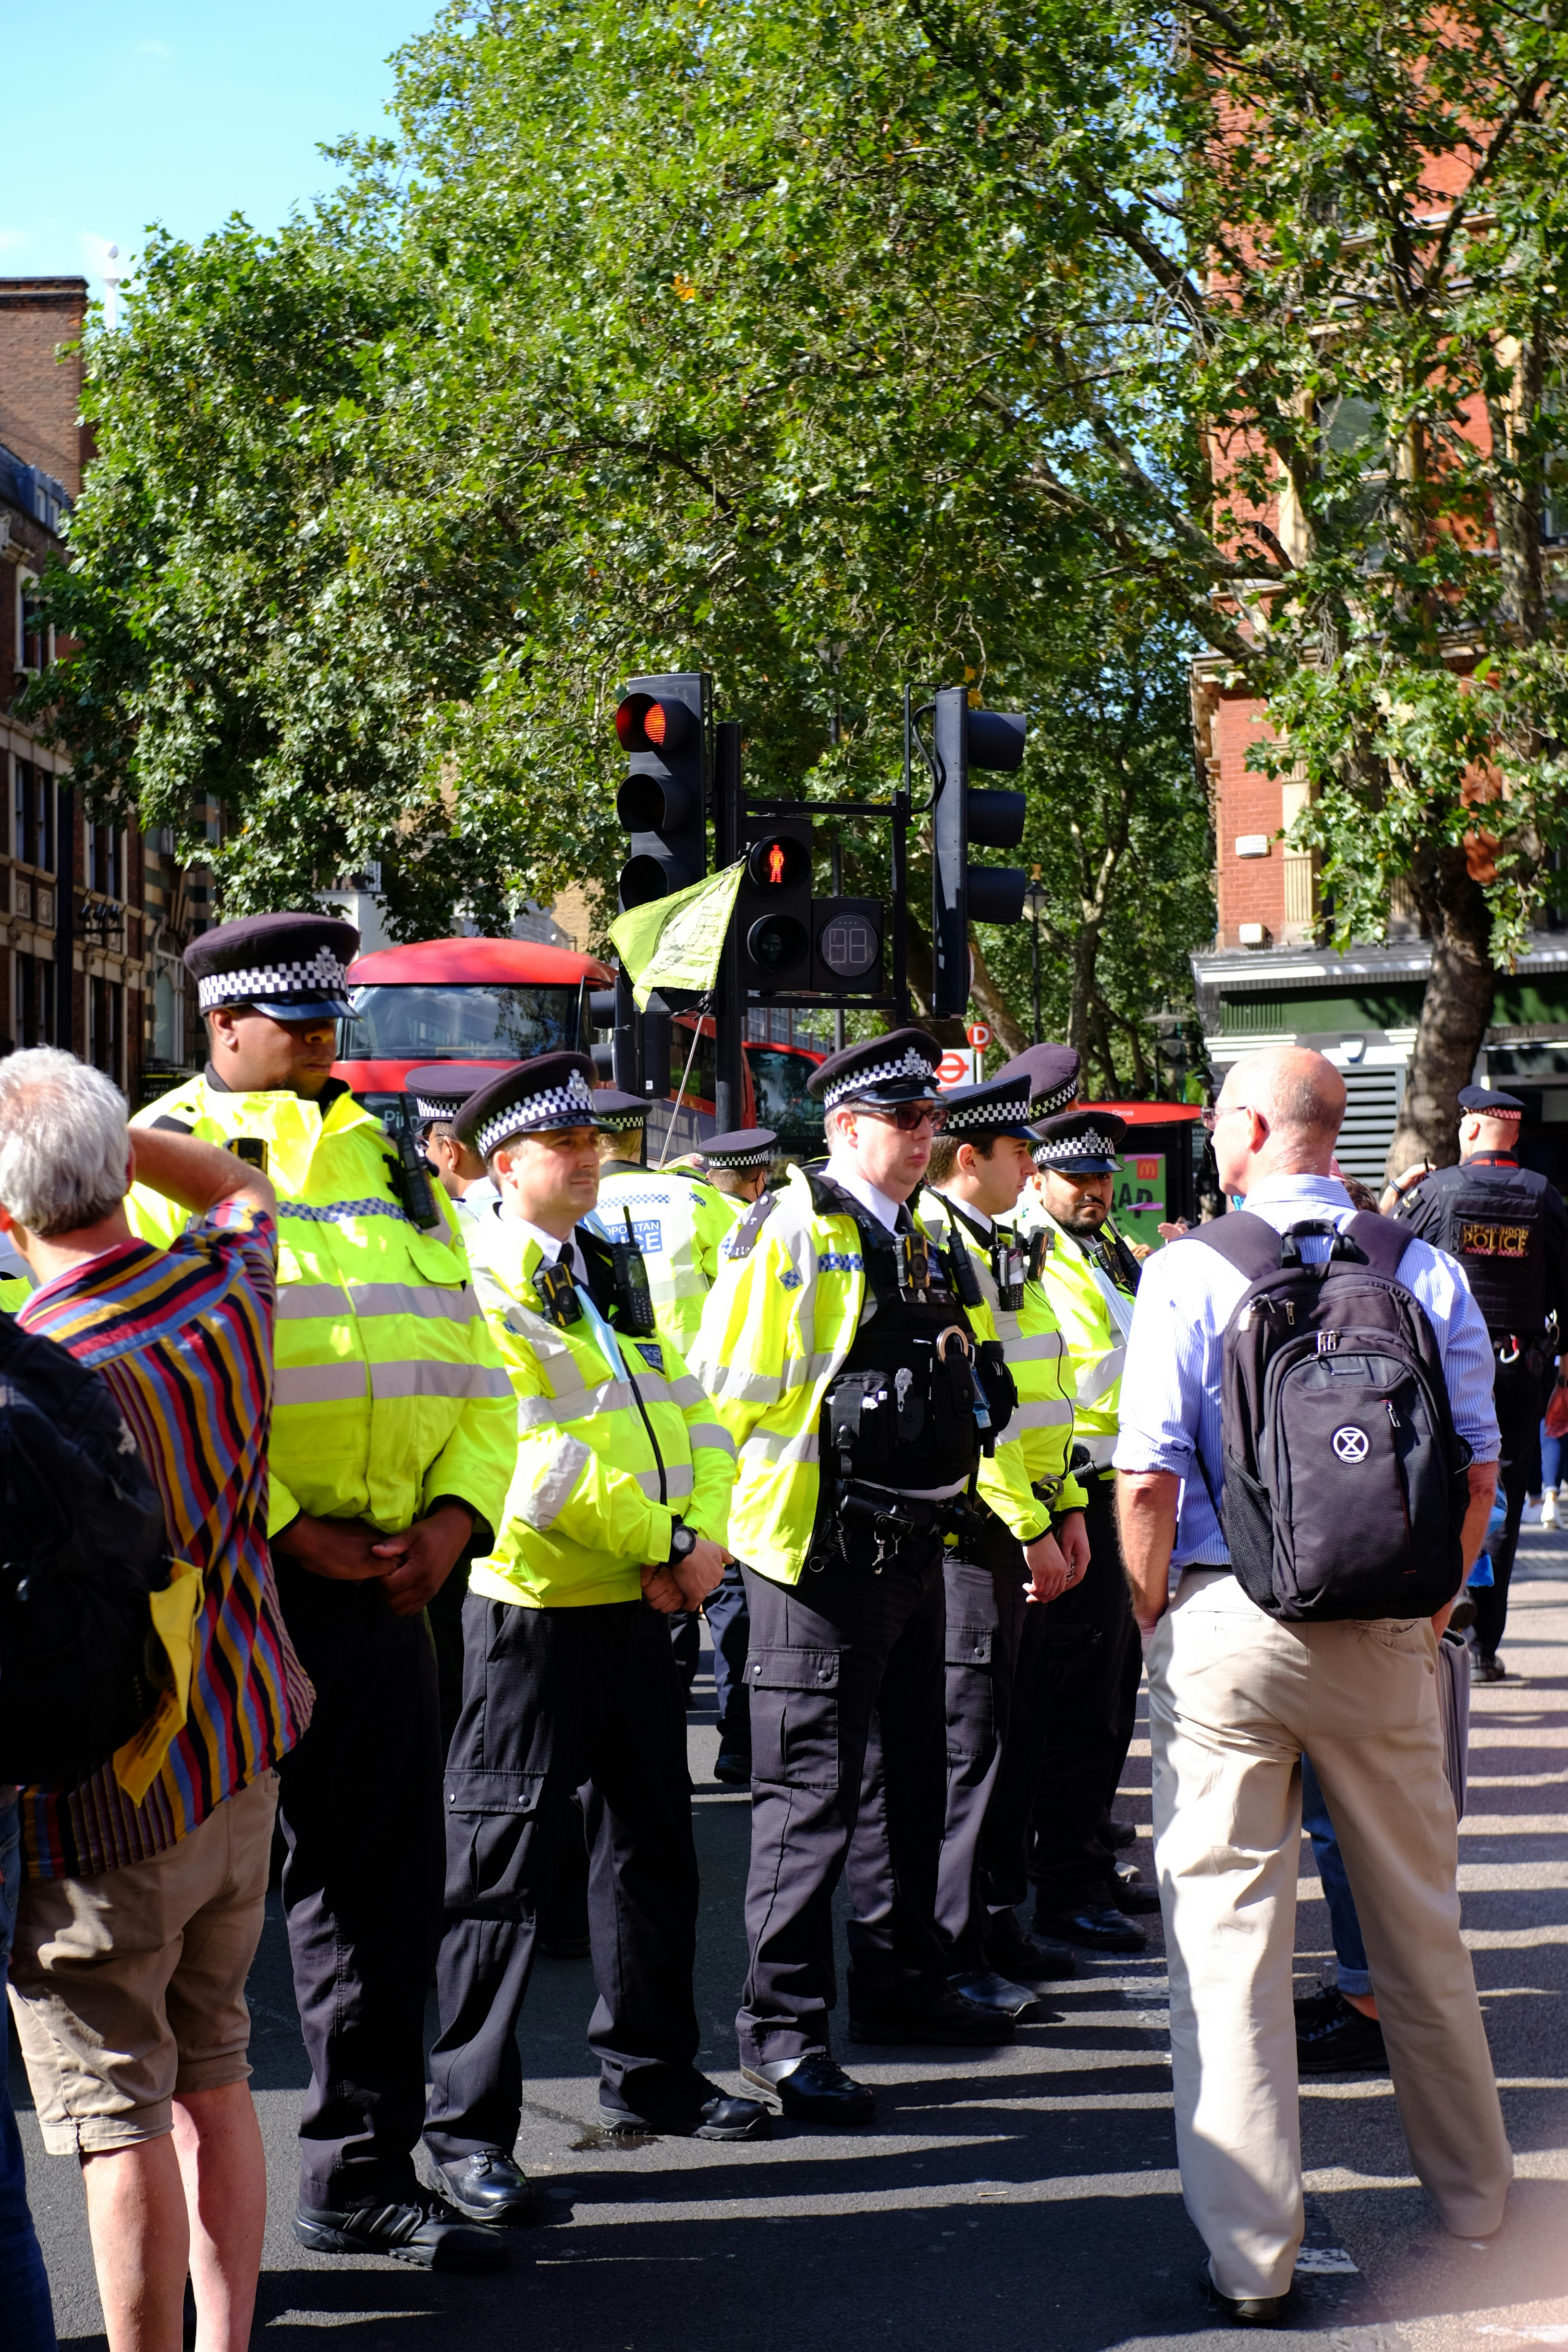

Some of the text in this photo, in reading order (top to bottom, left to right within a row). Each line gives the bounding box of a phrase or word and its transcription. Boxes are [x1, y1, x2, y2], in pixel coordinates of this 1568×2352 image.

[973, 1026, 989, 1044] D
[1463, 1224, 1484, 1233] CITY
[1491, 1226, 1529, 1237] LONDON
[1463, 1232, 1527, 1252] POLICE
